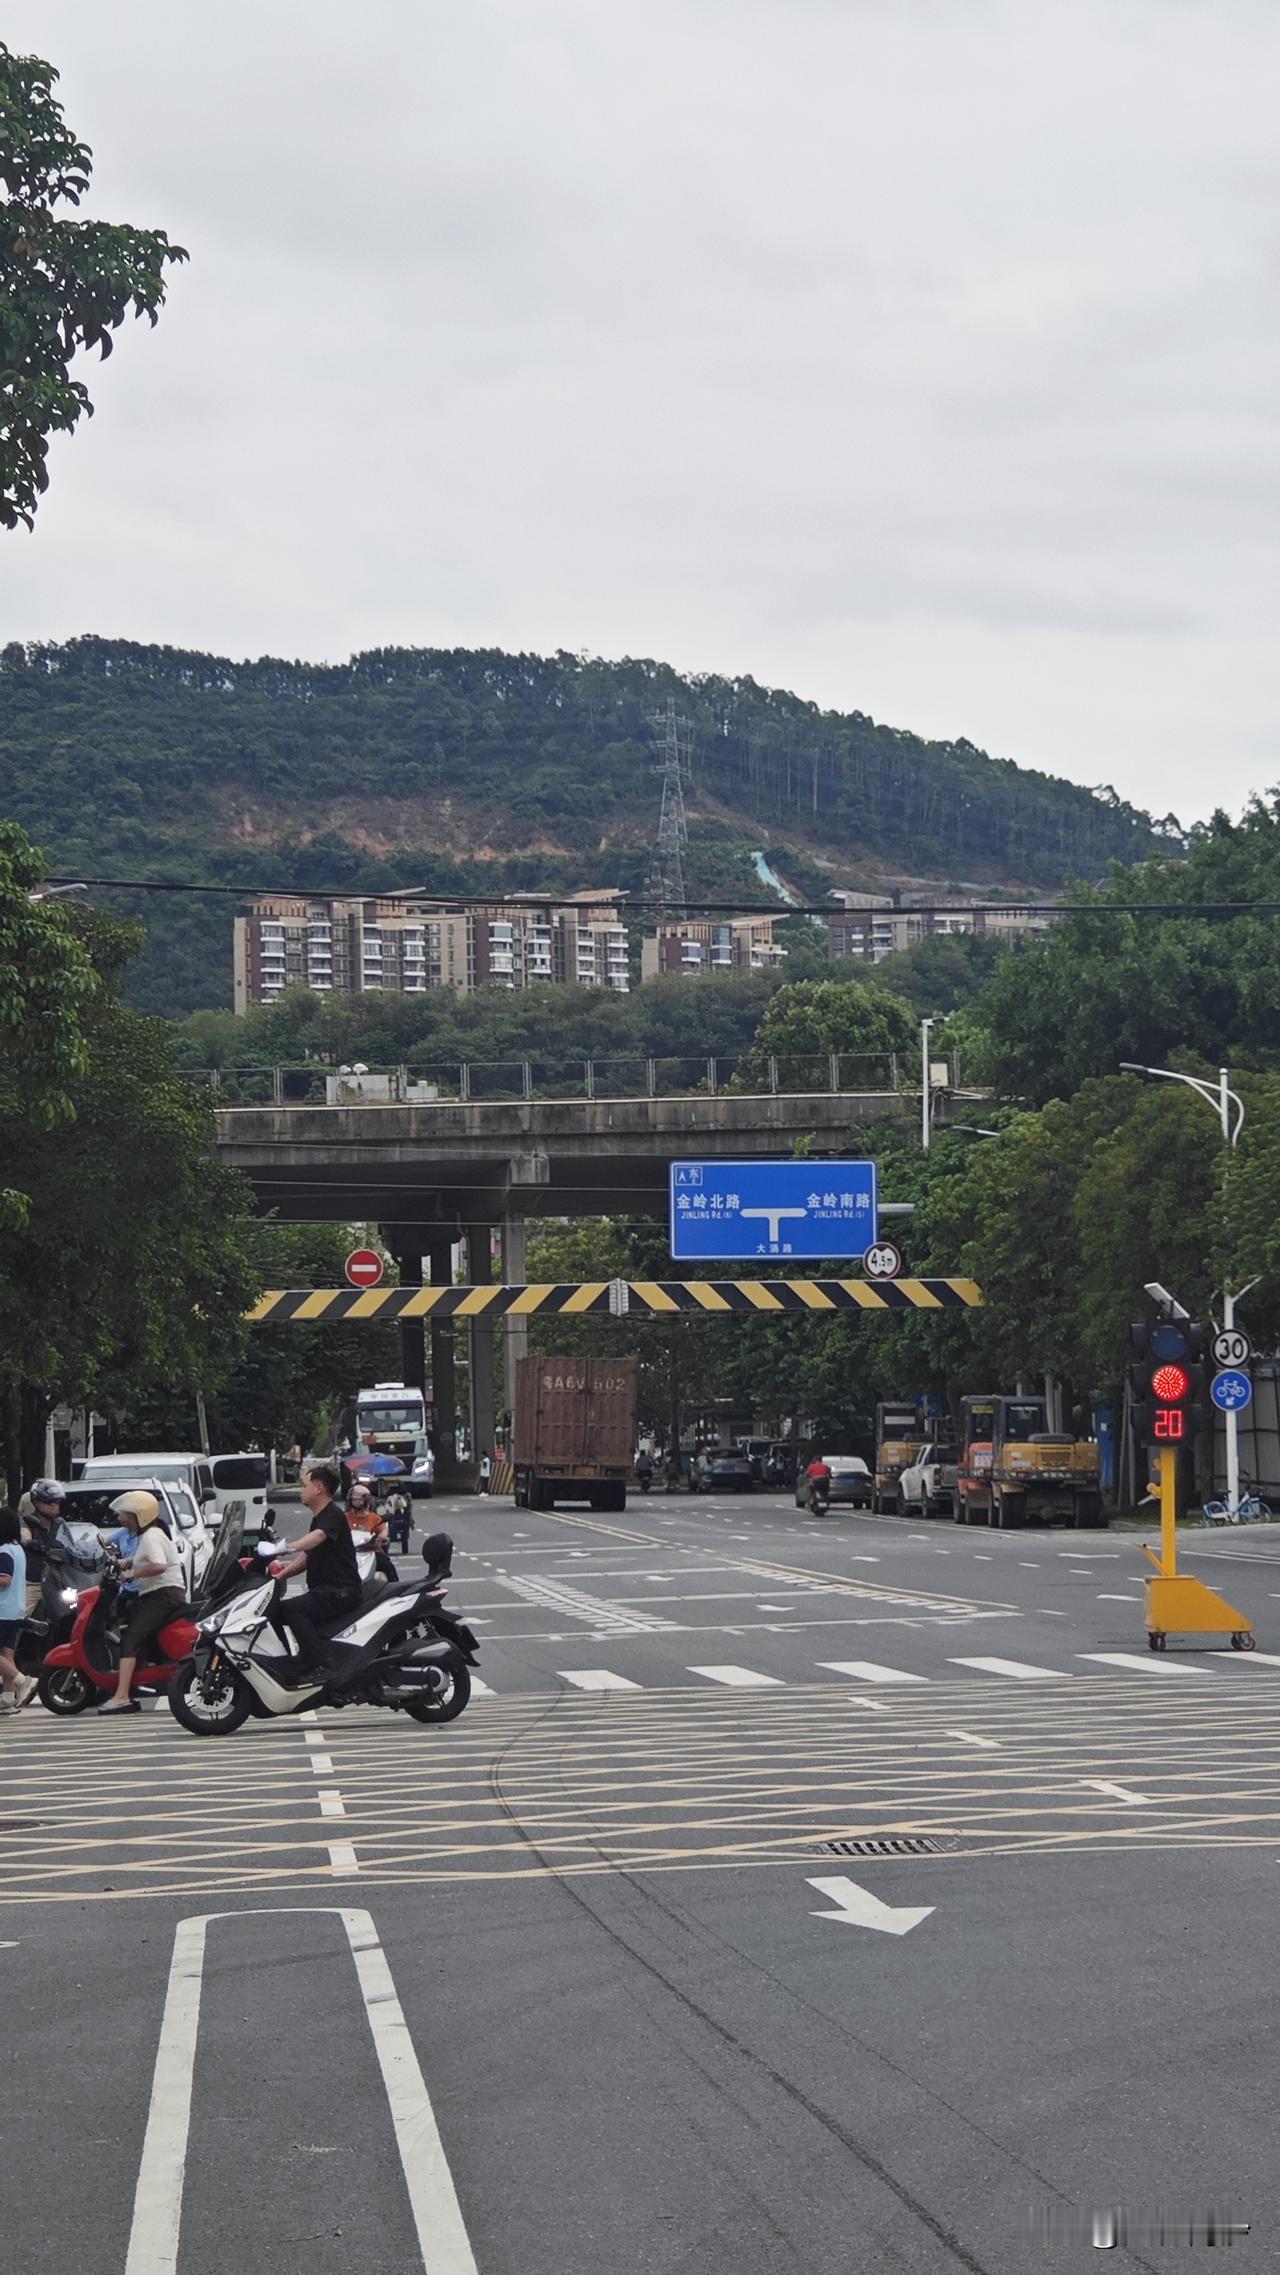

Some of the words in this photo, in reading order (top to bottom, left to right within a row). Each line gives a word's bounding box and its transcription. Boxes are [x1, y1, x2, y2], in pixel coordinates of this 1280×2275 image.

[677, 1193, 740, 1209] 金岭北路
[807, 1193, 870, 1208] 金岭南路
[681, 1210, 710, 1220] JINLING
[813, 1209, 842, 1219] JINLING
[1218, 1338, 1244, 1359] 30
[1154, 1410, 1182, 1437] 20
